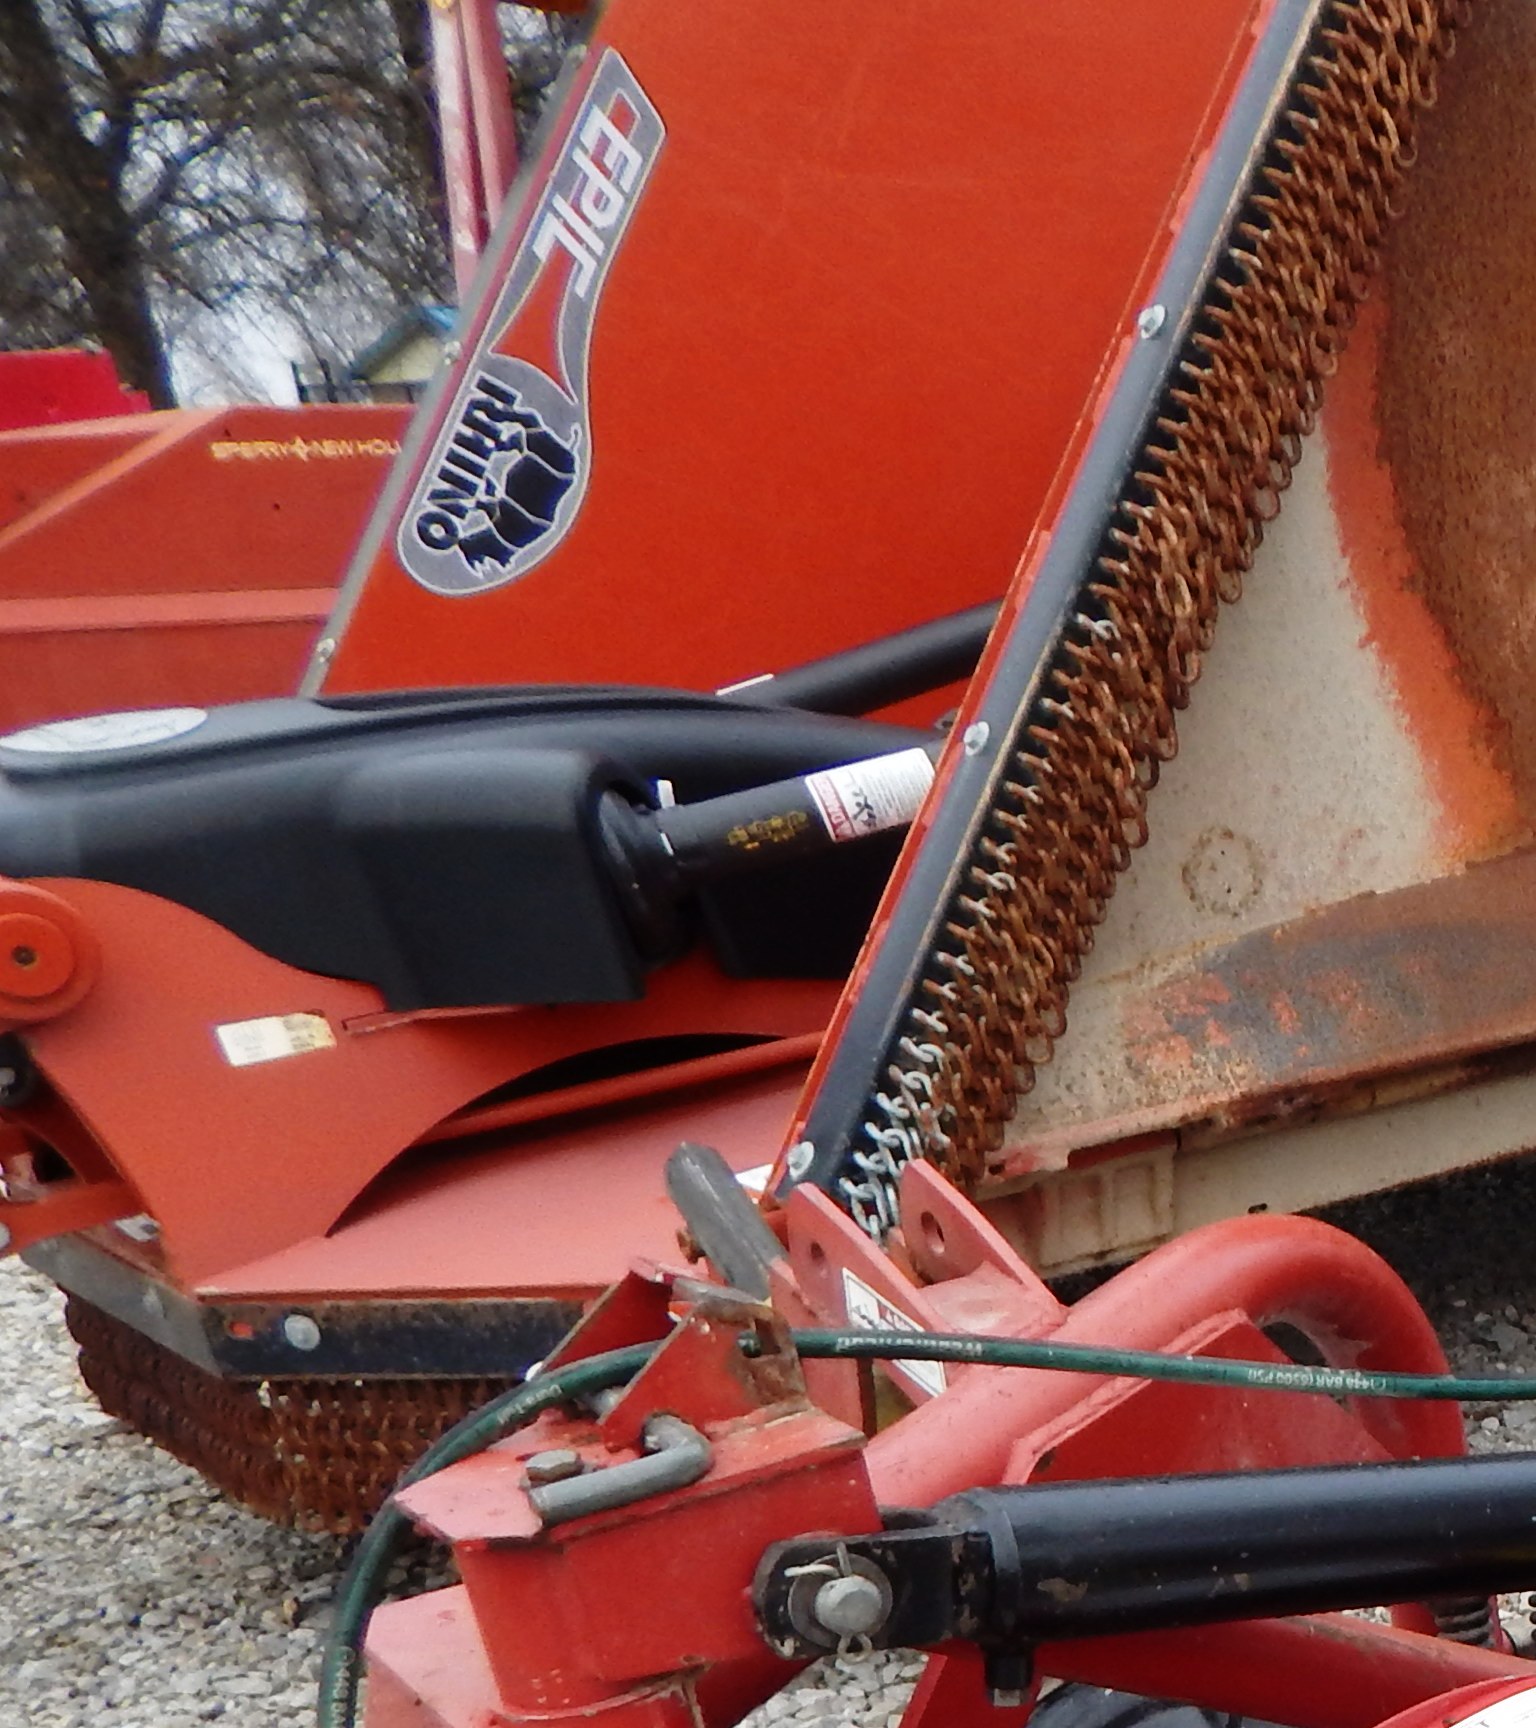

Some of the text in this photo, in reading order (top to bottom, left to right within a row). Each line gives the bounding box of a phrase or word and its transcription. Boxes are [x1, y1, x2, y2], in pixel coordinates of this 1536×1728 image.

[533, 104, 643, 298] EPIC
[306, 440, 354, 457] NEW
[415, 374, 524, 551] RHINO
